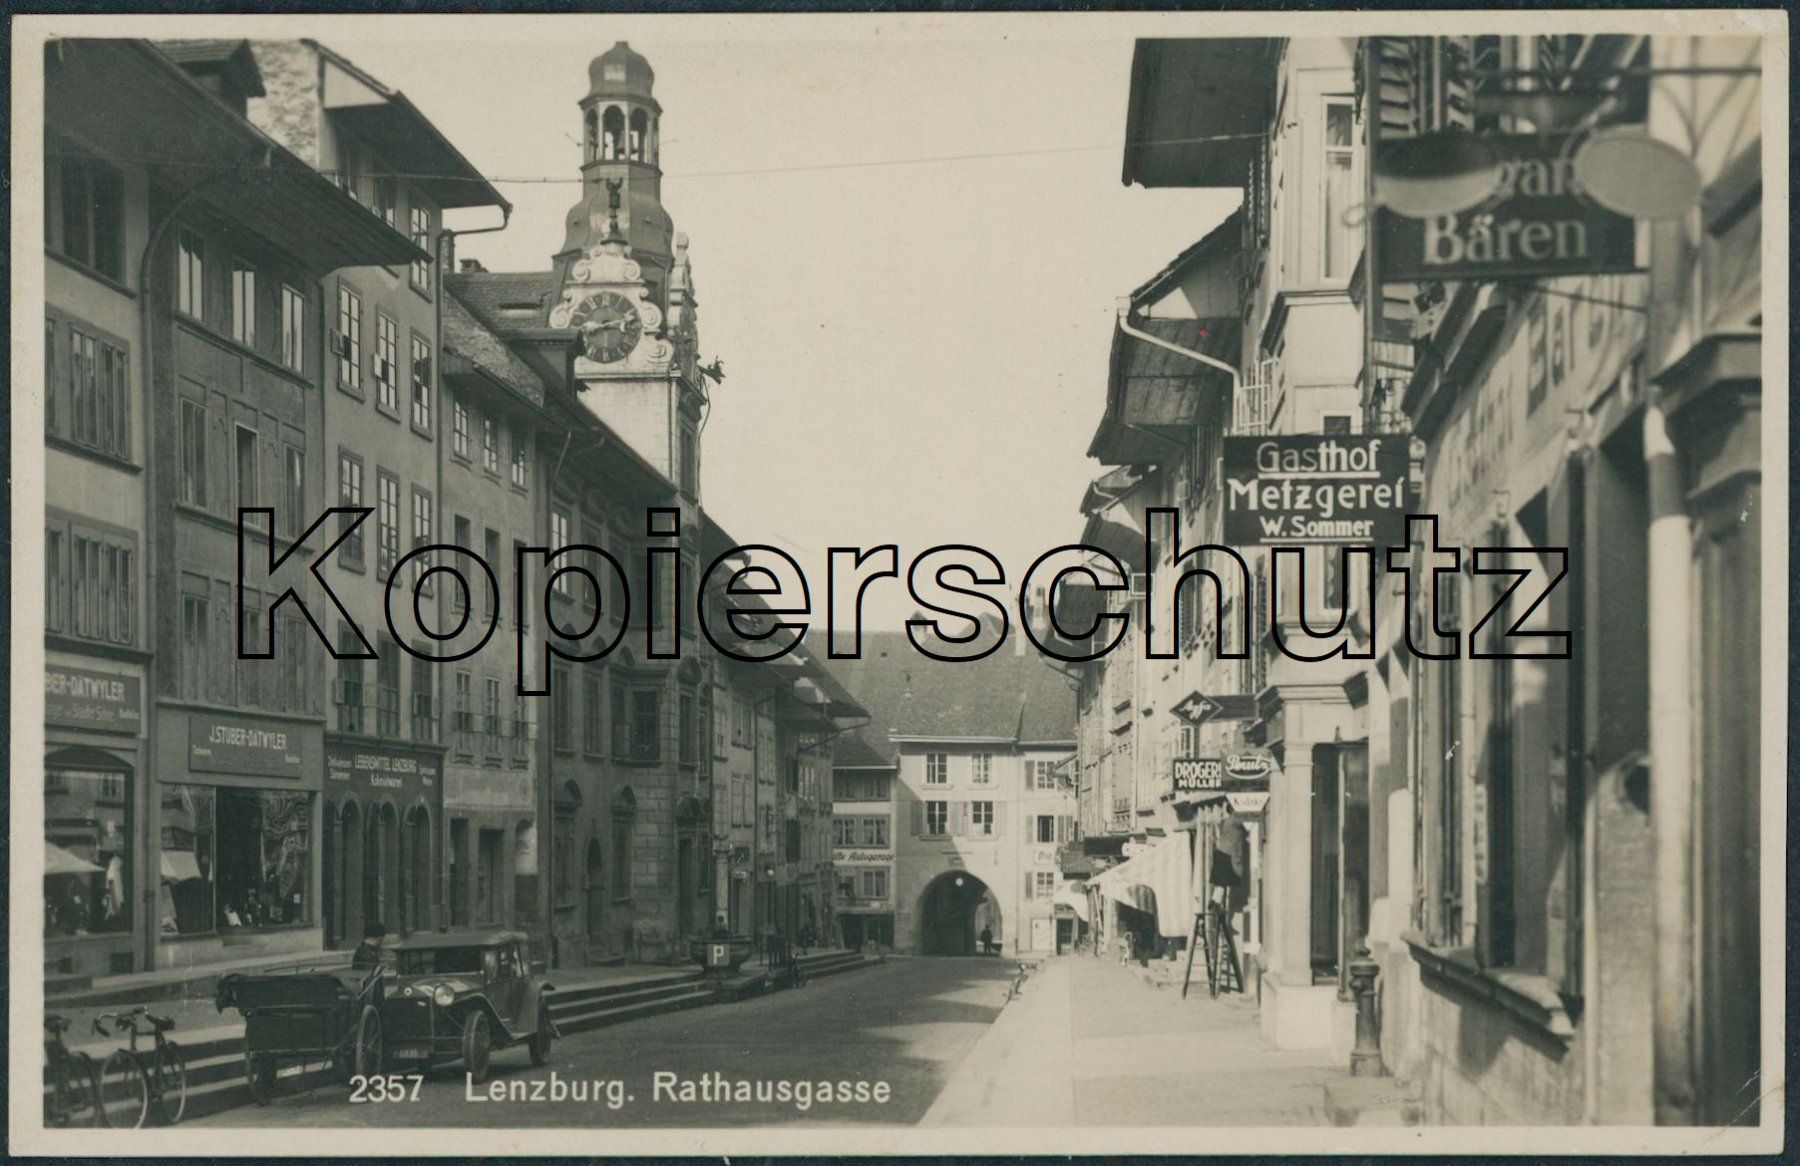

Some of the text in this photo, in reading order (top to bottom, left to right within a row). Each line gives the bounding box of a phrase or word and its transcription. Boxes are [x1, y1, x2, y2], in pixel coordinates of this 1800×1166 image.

[1423, 214, 1588, 265] Bären
[1257, 439, 1381, 472] Gasthof
[1227, 476, 1405, 518] Metzgerei
[713, 945, 725, 965] P
